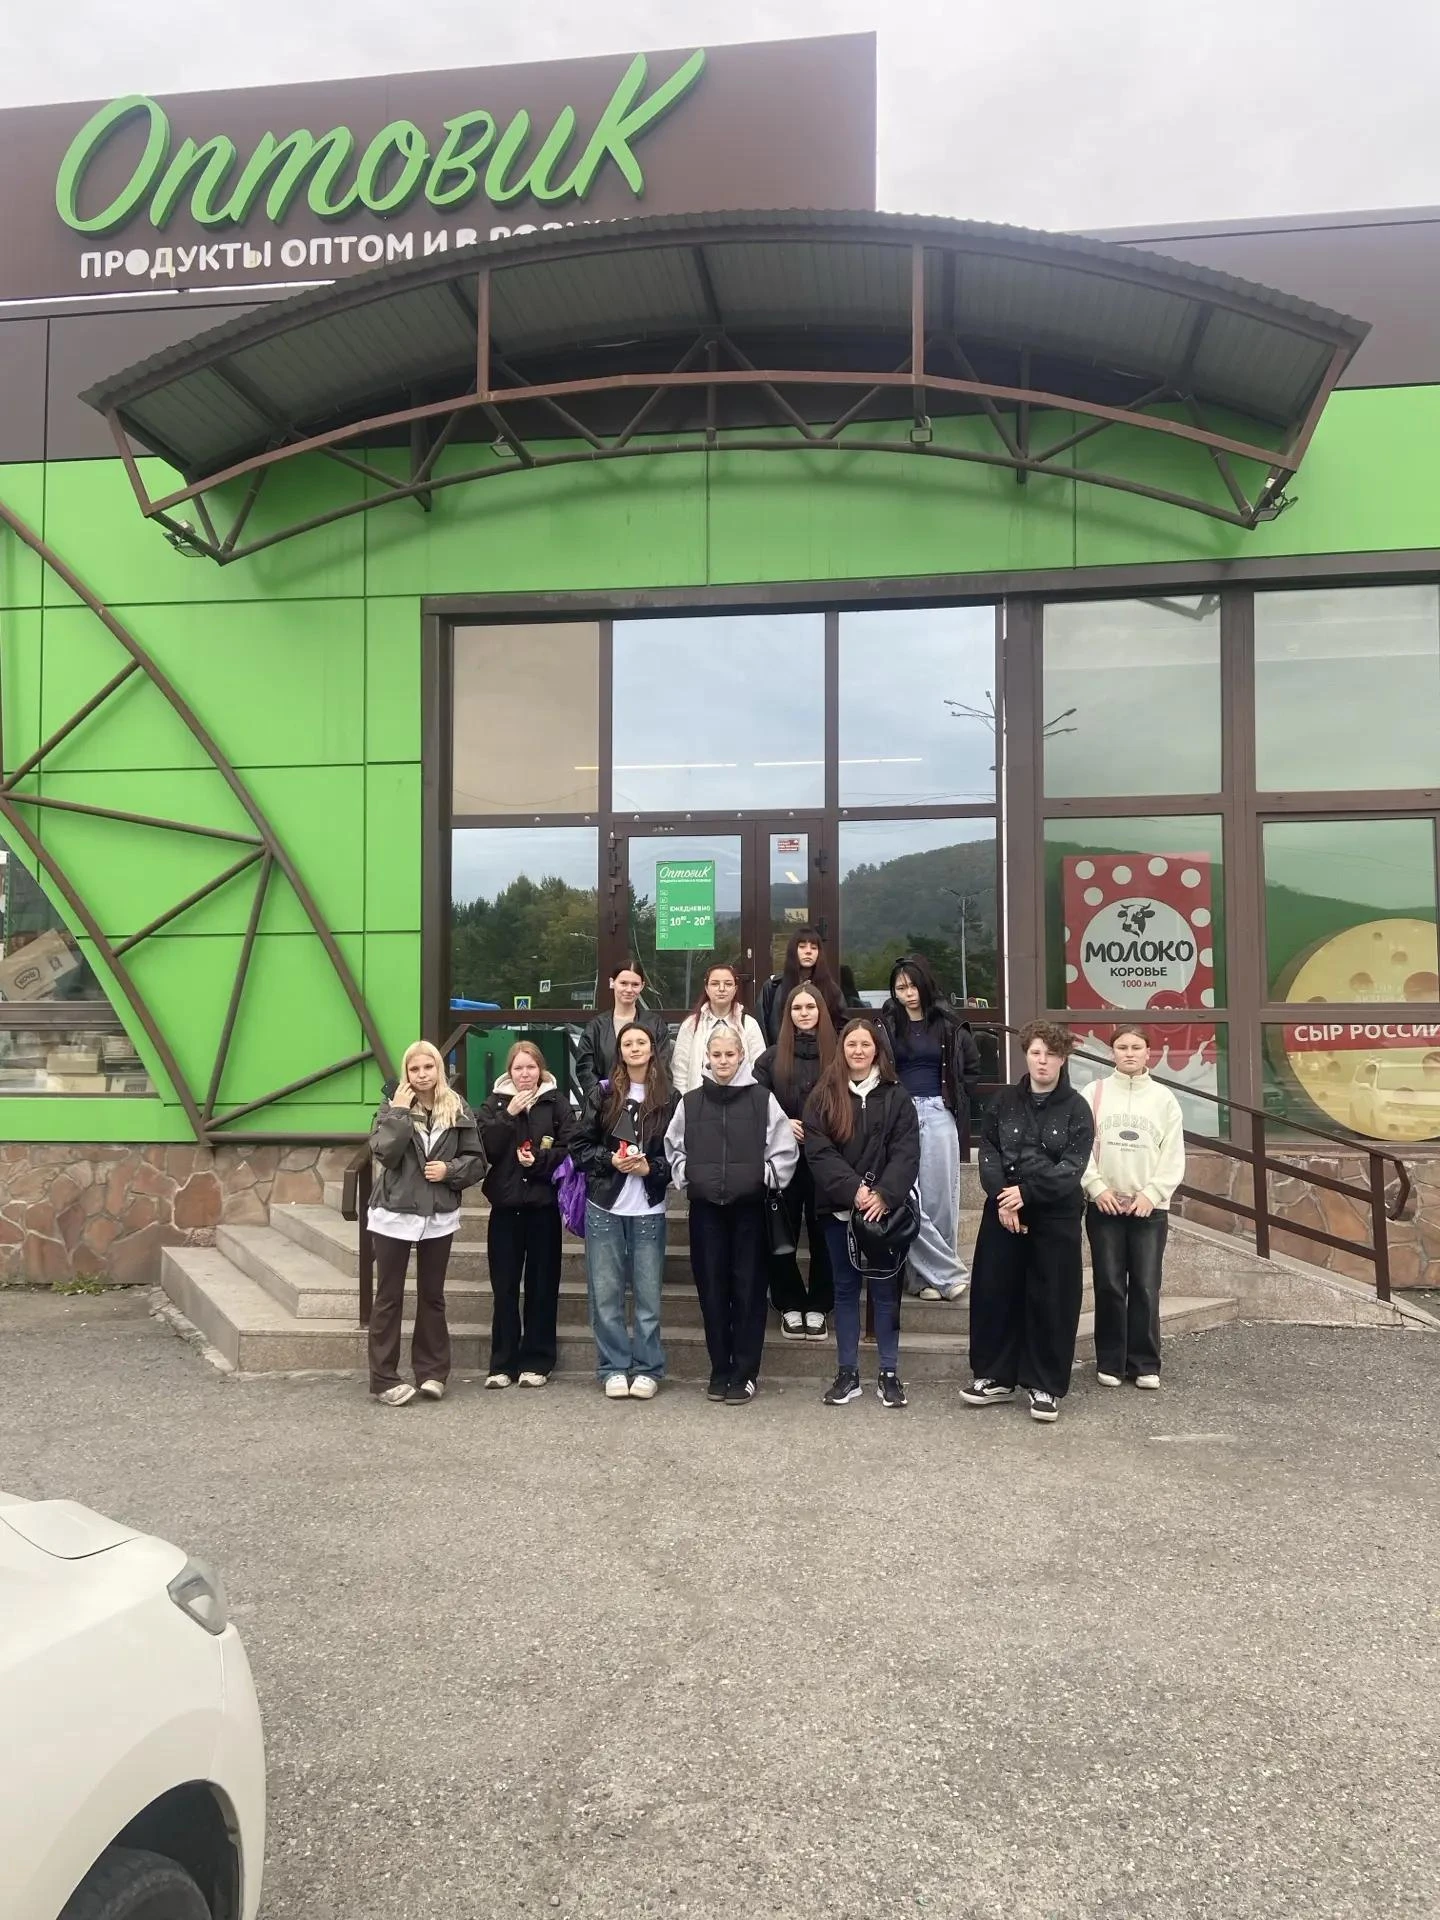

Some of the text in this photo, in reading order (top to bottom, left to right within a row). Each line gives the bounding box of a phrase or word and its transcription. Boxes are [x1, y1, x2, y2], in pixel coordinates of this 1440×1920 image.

[80, 240, 272, 280] ПРОДУКТЫ
[280, 231, 414, 267] ОПТОМ
[423, 229, 448, 257] И
[1085, 940, 1194, 963] МОЛОКО
[1110, 966, 1168, 977] КОРОВЬЕ
[1121, 979, 1157, 988] 1000 мл
[1294, 1025, 1344, 1042] СЫР
